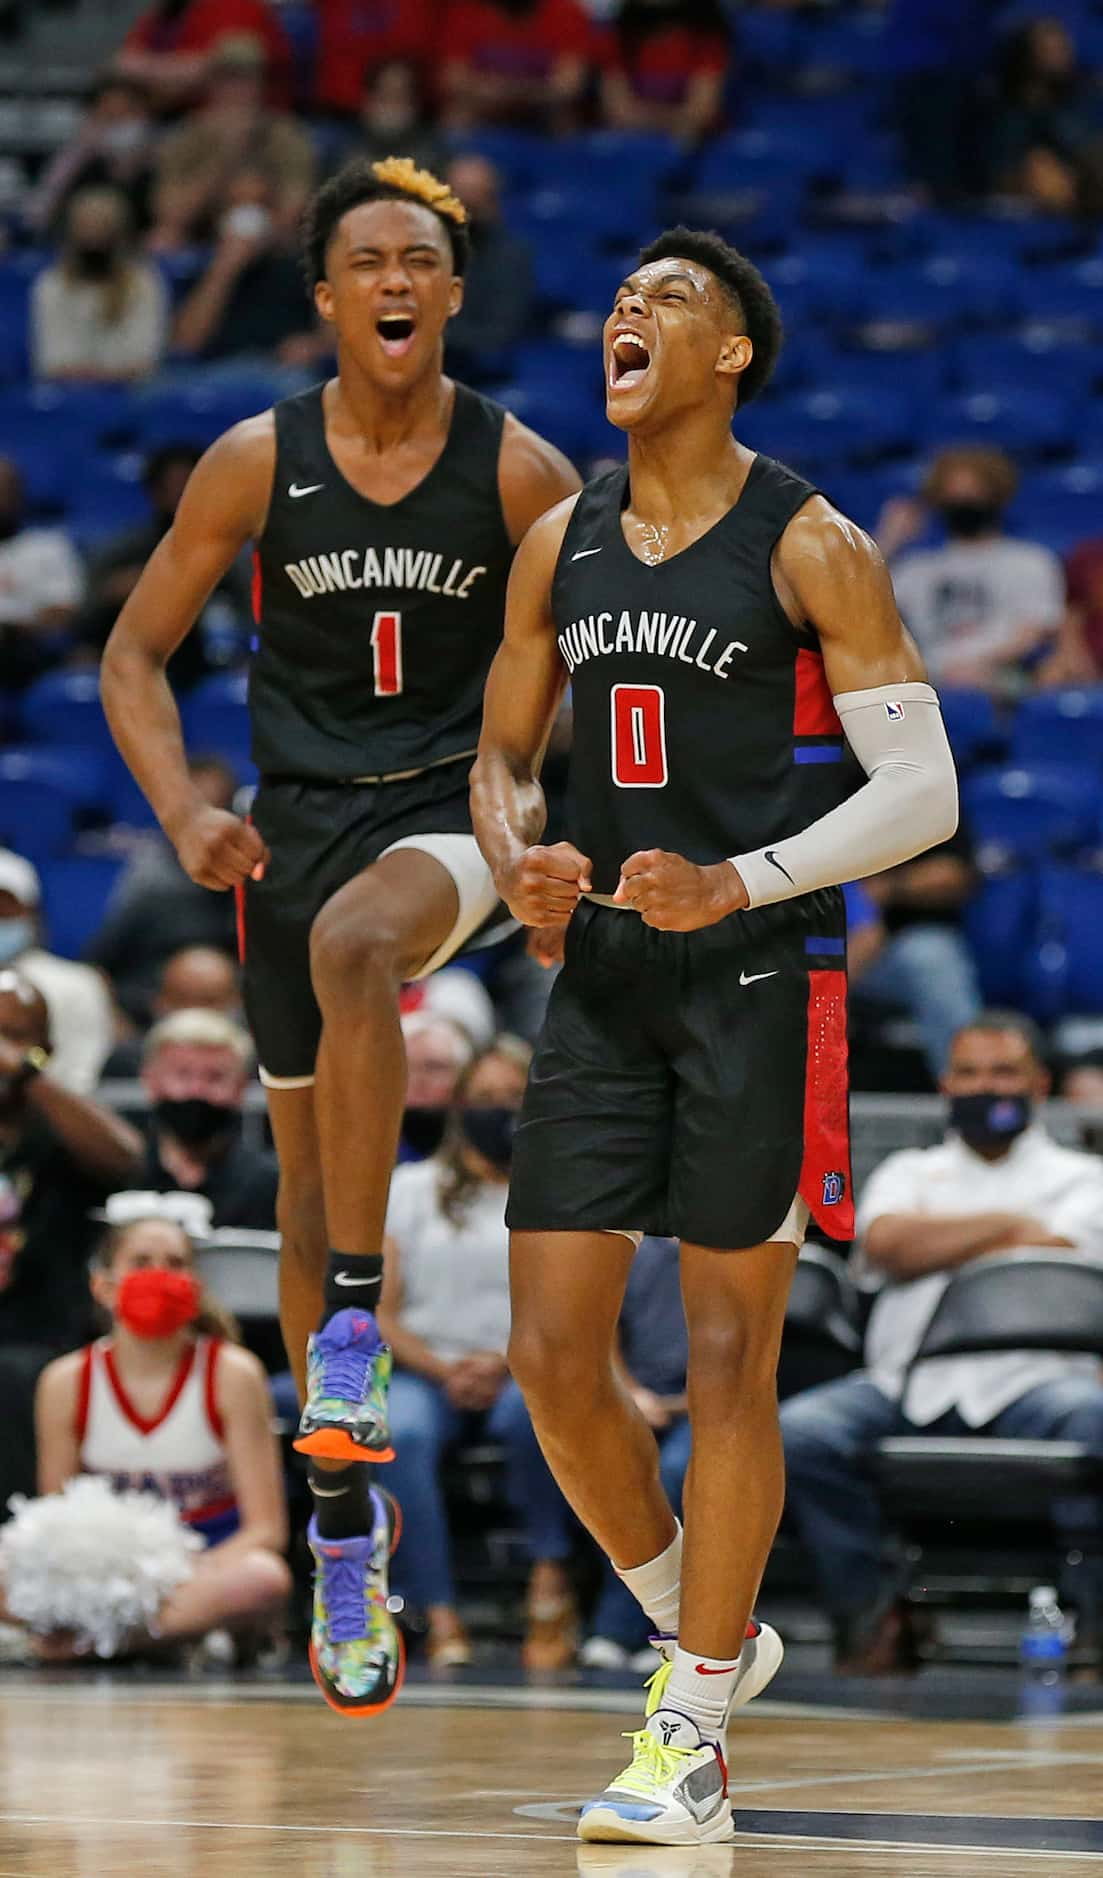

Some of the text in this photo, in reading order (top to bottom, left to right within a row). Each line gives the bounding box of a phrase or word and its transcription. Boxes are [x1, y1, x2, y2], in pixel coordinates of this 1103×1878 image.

[284, 547, 487, 599] DUNCANVILLE
[370, 611, 402, 696] 1
[558, 610, 748, 679] DUNCANVILLE
[611, 683, 668, 788] 0
